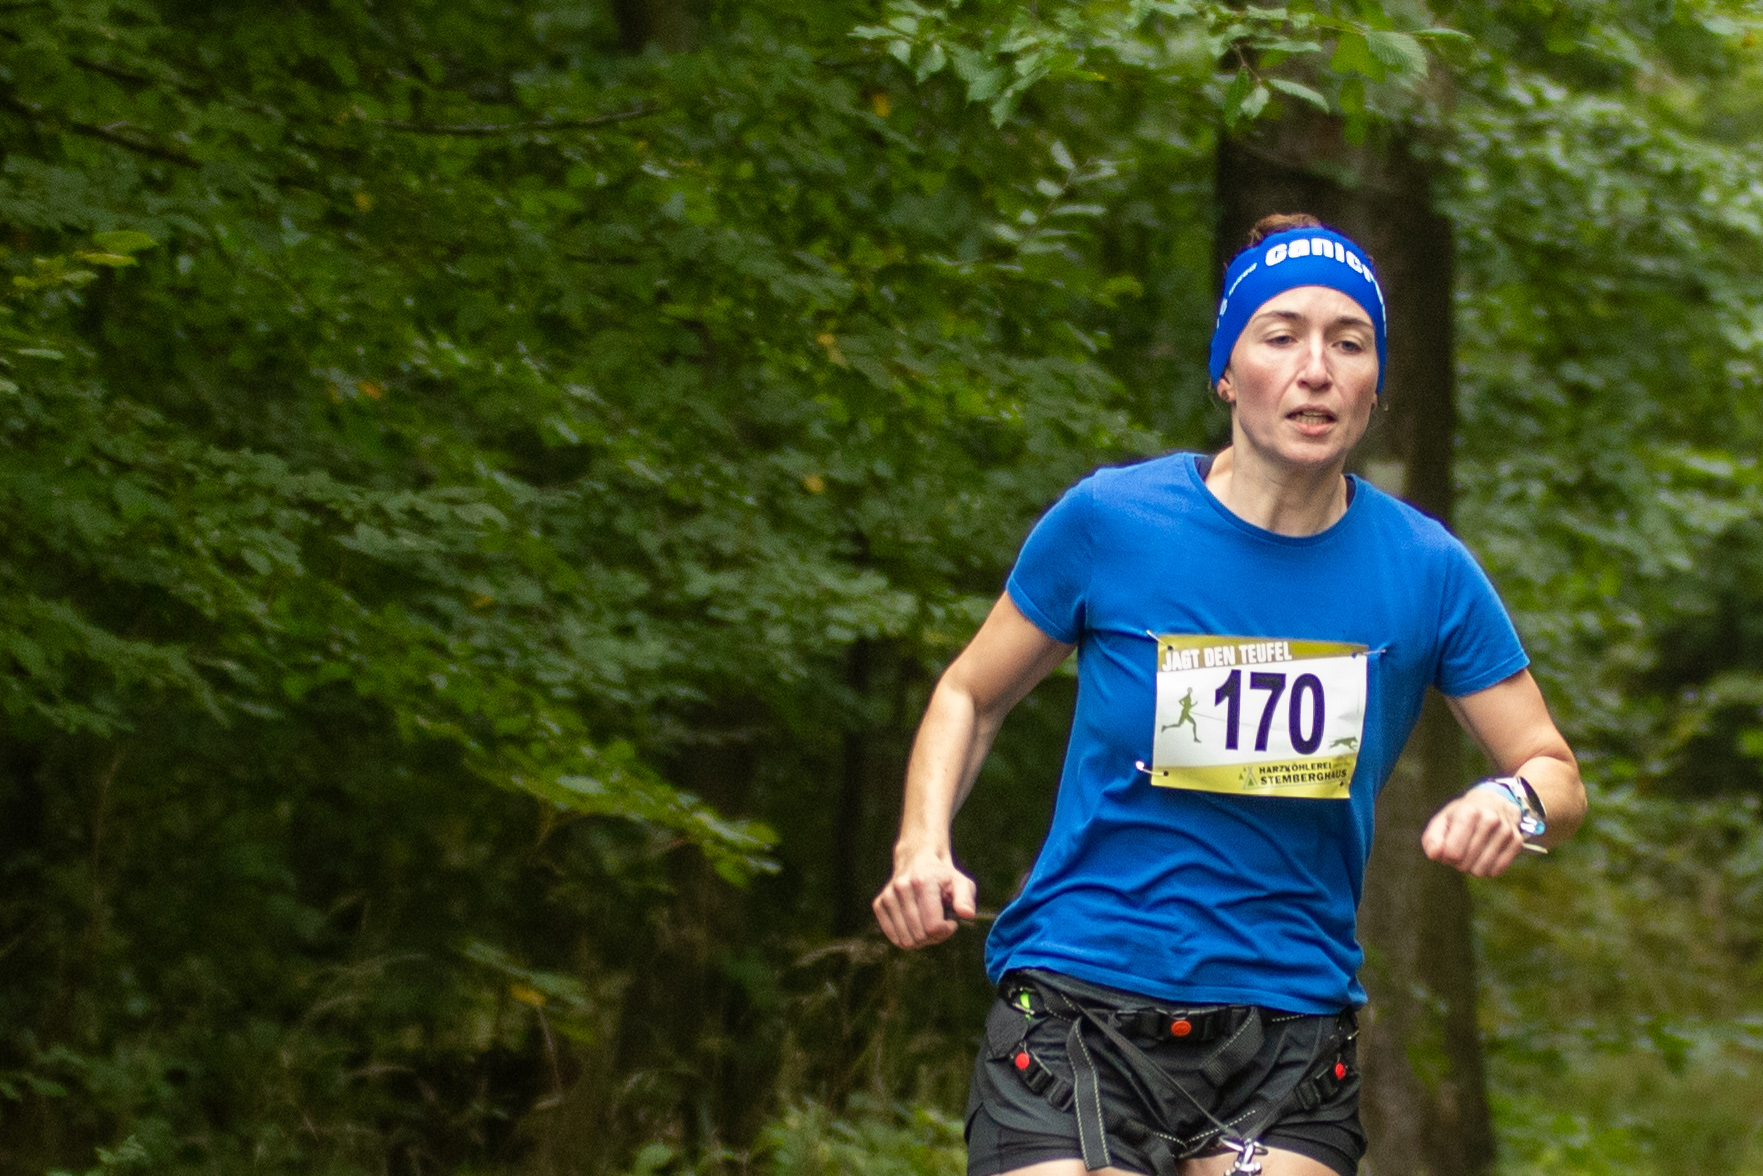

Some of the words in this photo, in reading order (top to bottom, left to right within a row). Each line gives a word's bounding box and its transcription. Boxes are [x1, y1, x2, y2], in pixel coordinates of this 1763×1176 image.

[1162, 648, 1200, 672] JAGT
[1203, 645, 1236, 667] DEN
[1239, 641, 1293, 664] TEUFEL
[1214, 668, 1326, 755] 170
[1260, 769, 1348, 786] STEMBERGHAUS
